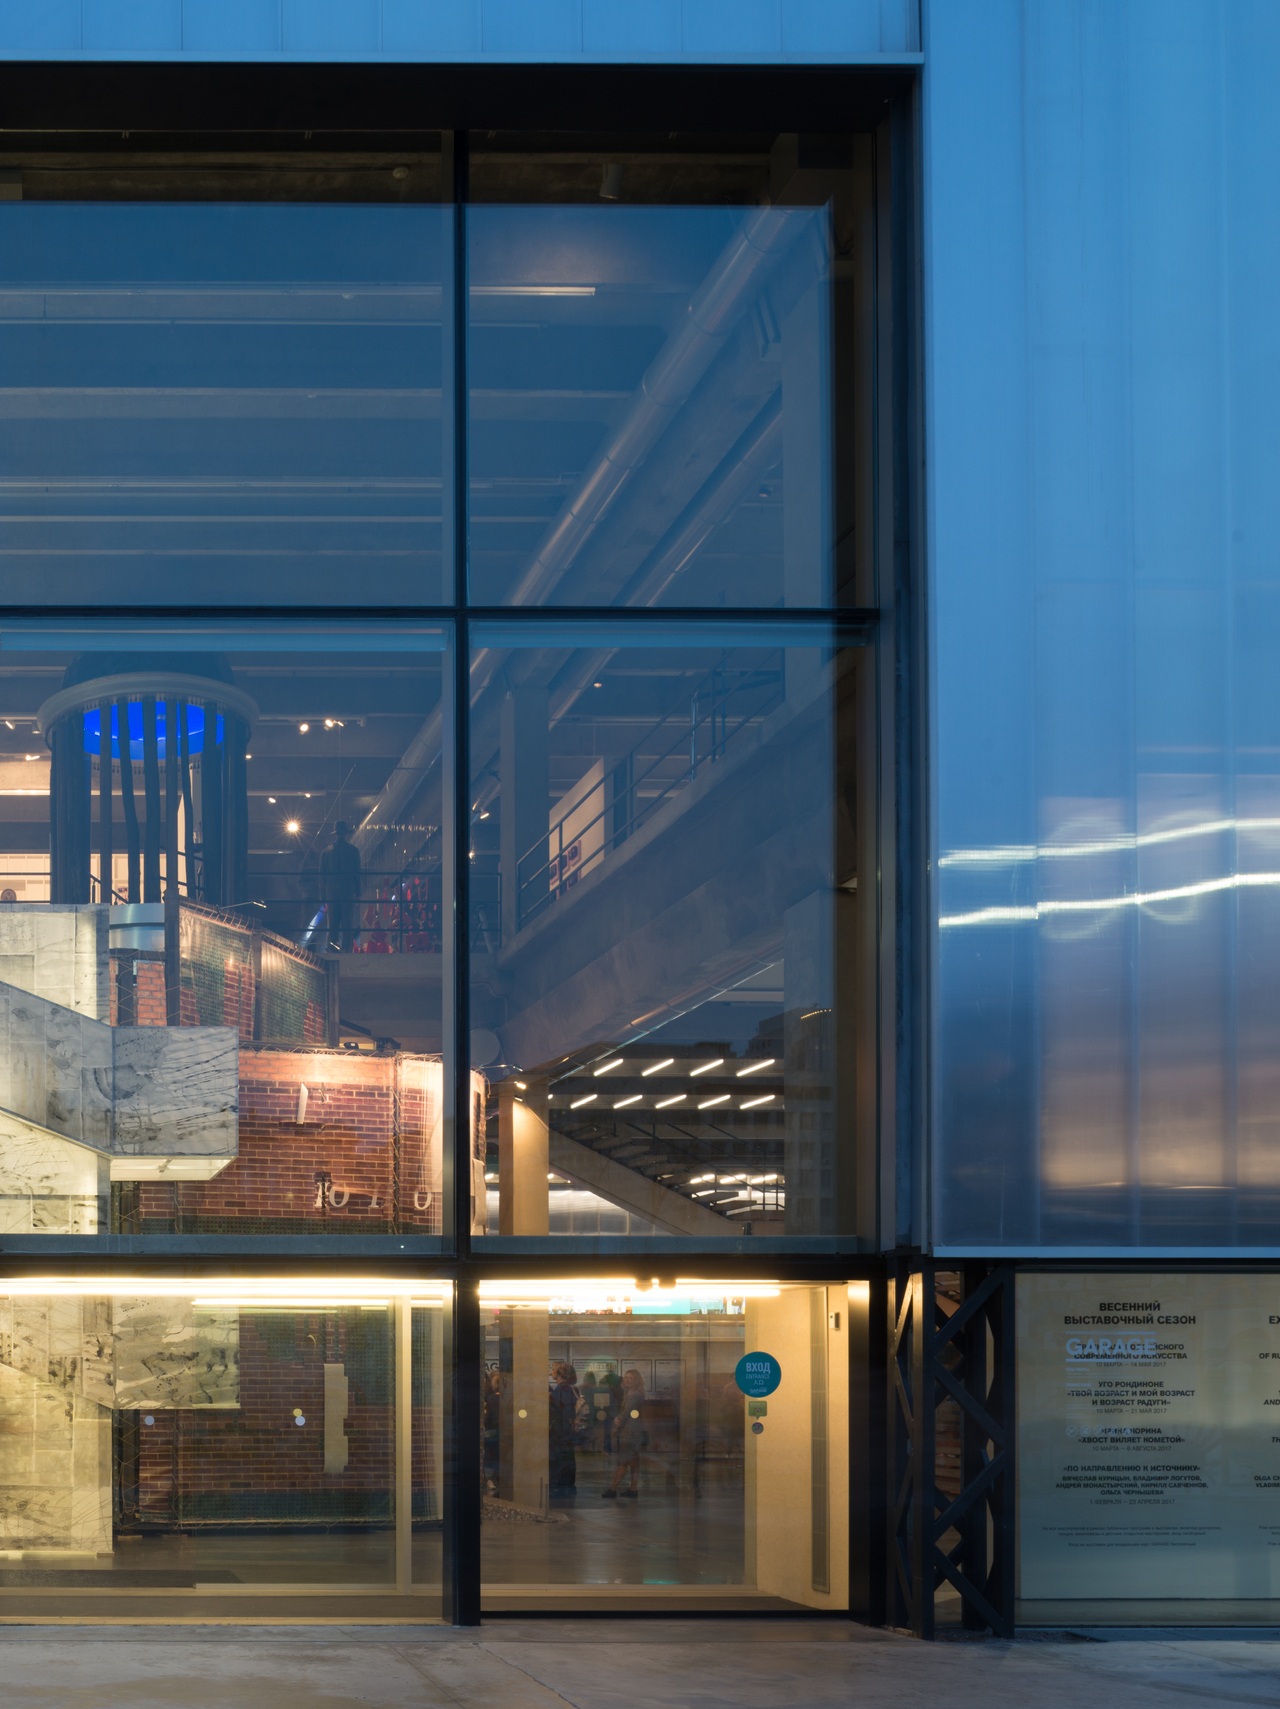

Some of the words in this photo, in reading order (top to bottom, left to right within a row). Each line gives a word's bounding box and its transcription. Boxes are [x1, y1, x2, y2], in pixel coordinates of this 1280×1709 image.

[1099, 1300, 1161, 1312] ВЕСЕННИЙ
[1064, 1313, 1154, 1325] ВЫСТАВОЧНЫЙ
[1157, 1315, 1196, 1325] СЕЗОН
[1065, 1337, 1157, 1356] GARAGE
[746, 1362, 770, 1374] ВХОД
[1115, 1381, 1164, 1389] РОНДИНОНЕ
[1139, 1388, 1158, 1397] МОЙ
[1056, 1481, 1082, 1489] АНДРЕЙ
